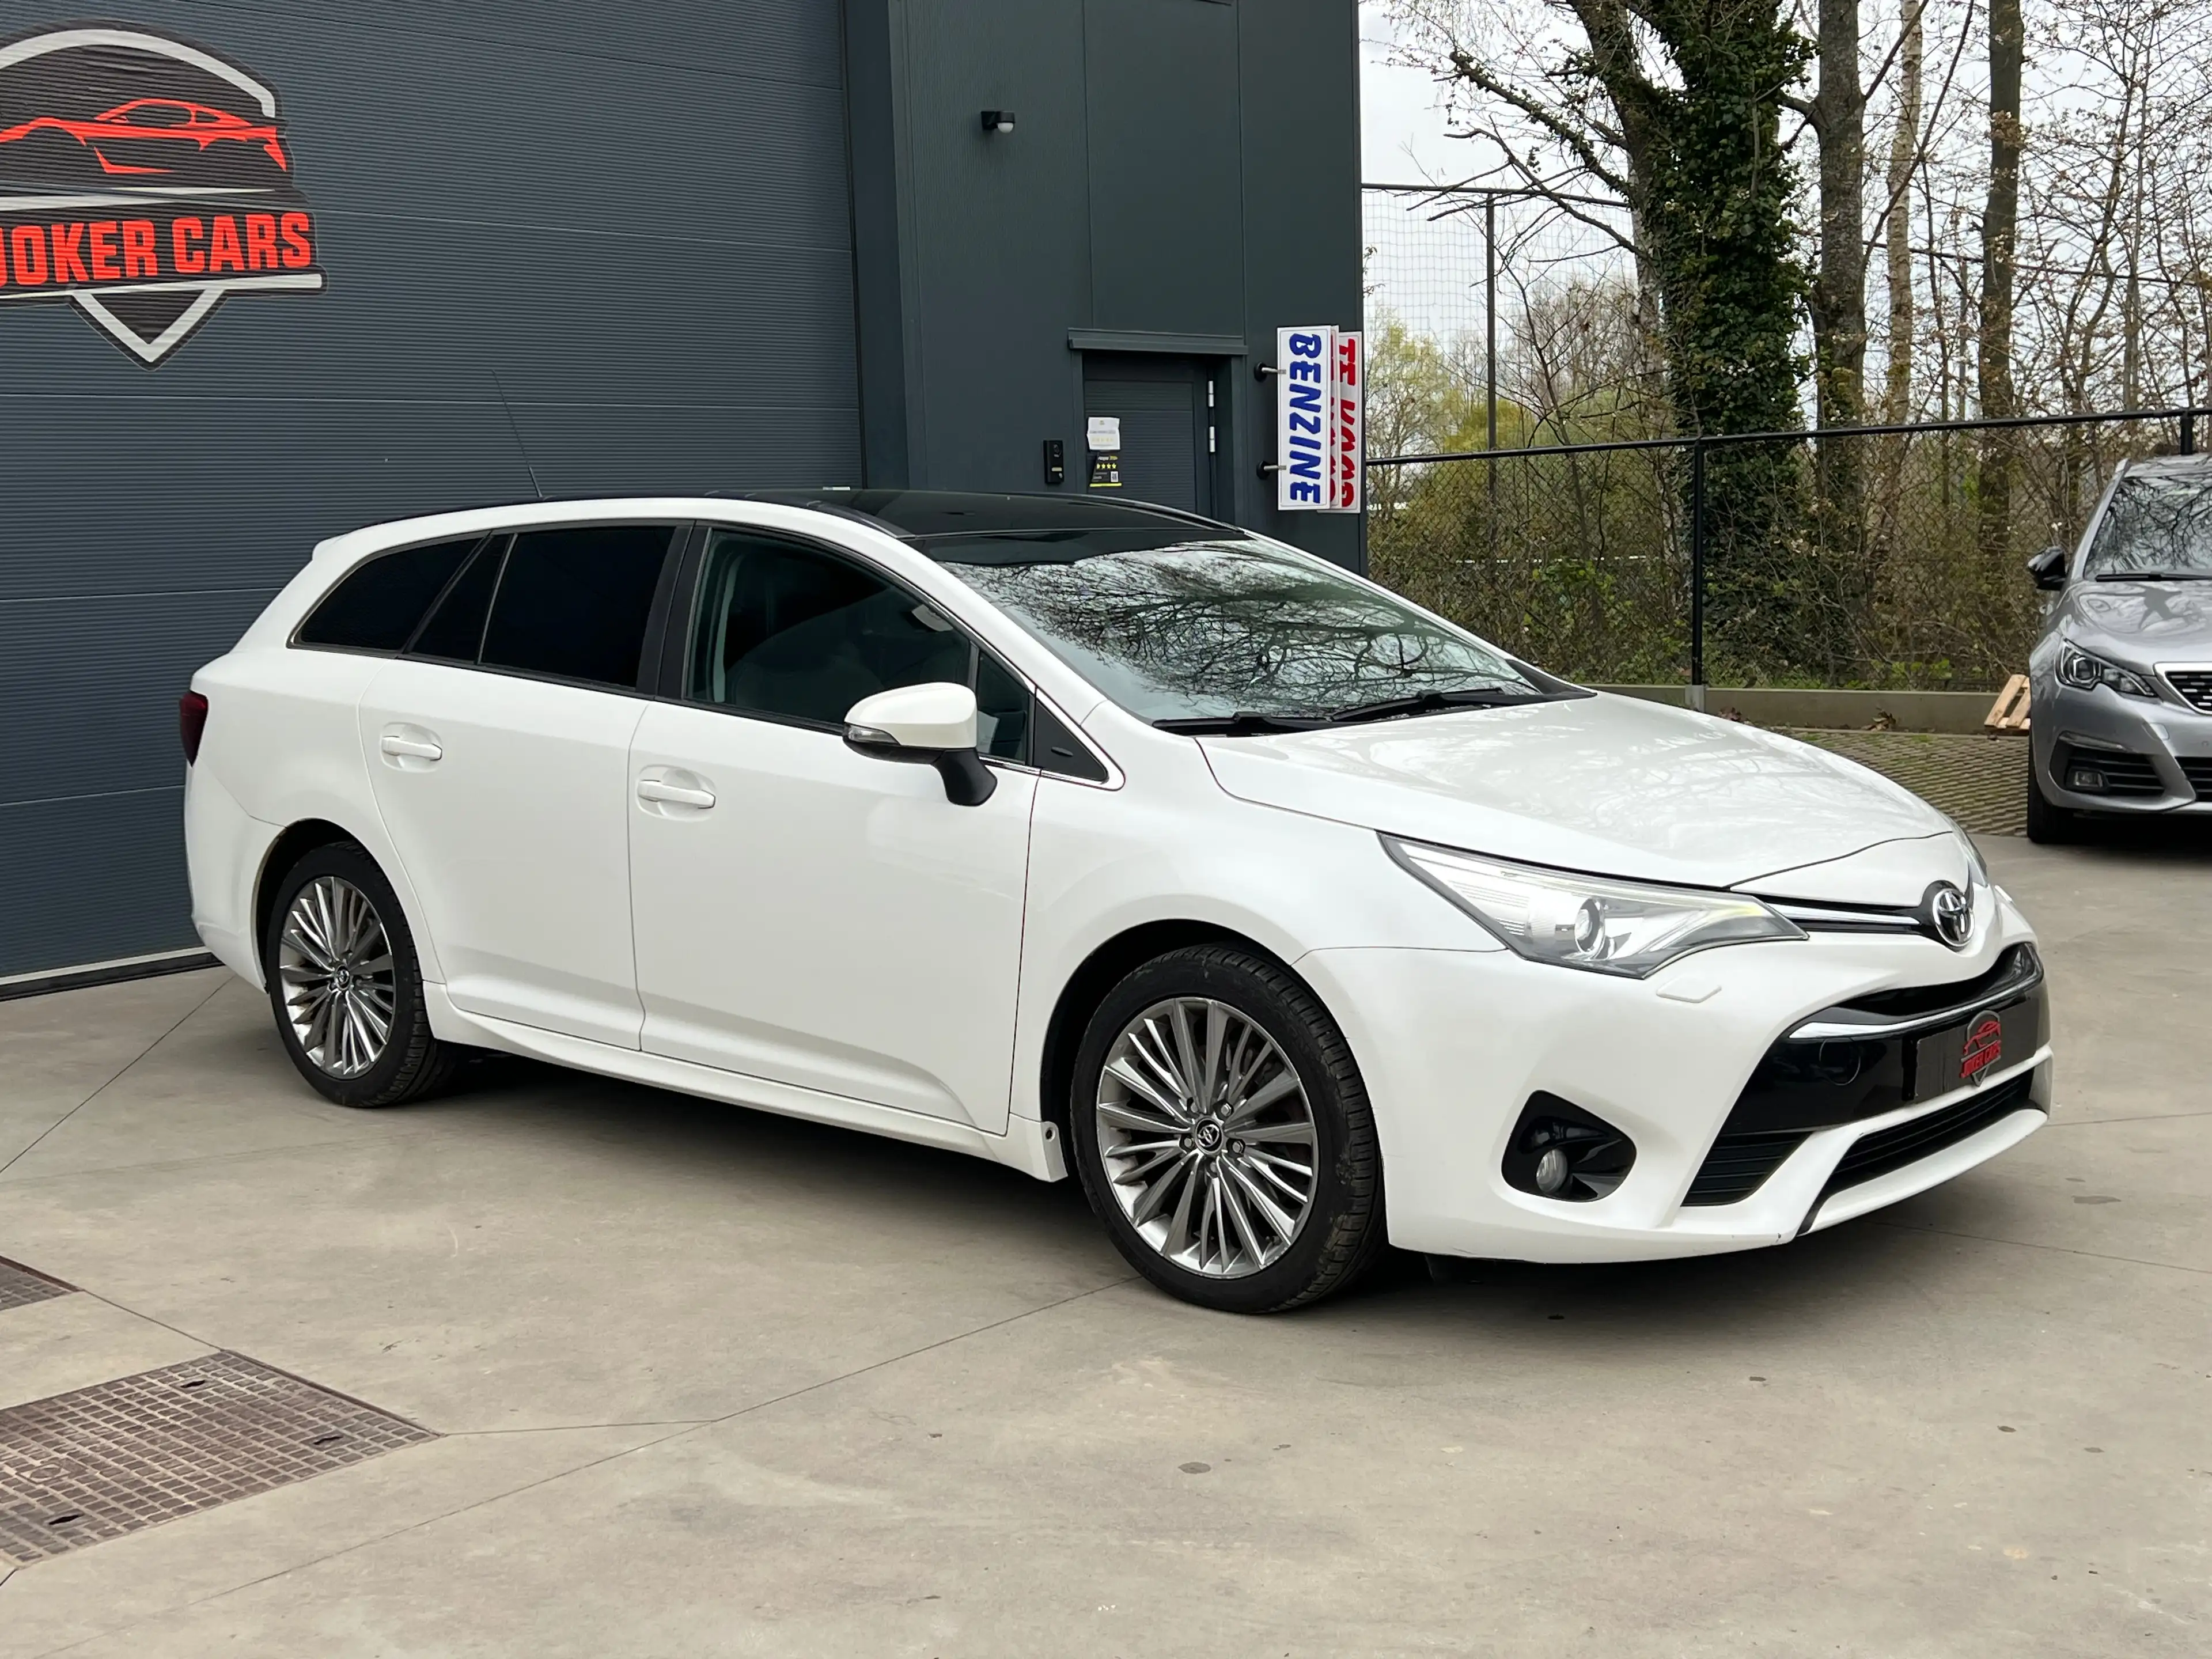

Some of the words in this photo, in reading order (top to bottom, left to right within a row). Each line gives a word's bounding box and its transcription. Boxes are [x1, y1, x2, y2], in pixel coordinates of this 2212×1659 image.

[0, 220, 158, 287] OKER
[172, 213, 311, 273] CARS
[1289, 333, 1321, 503] BENZINE
